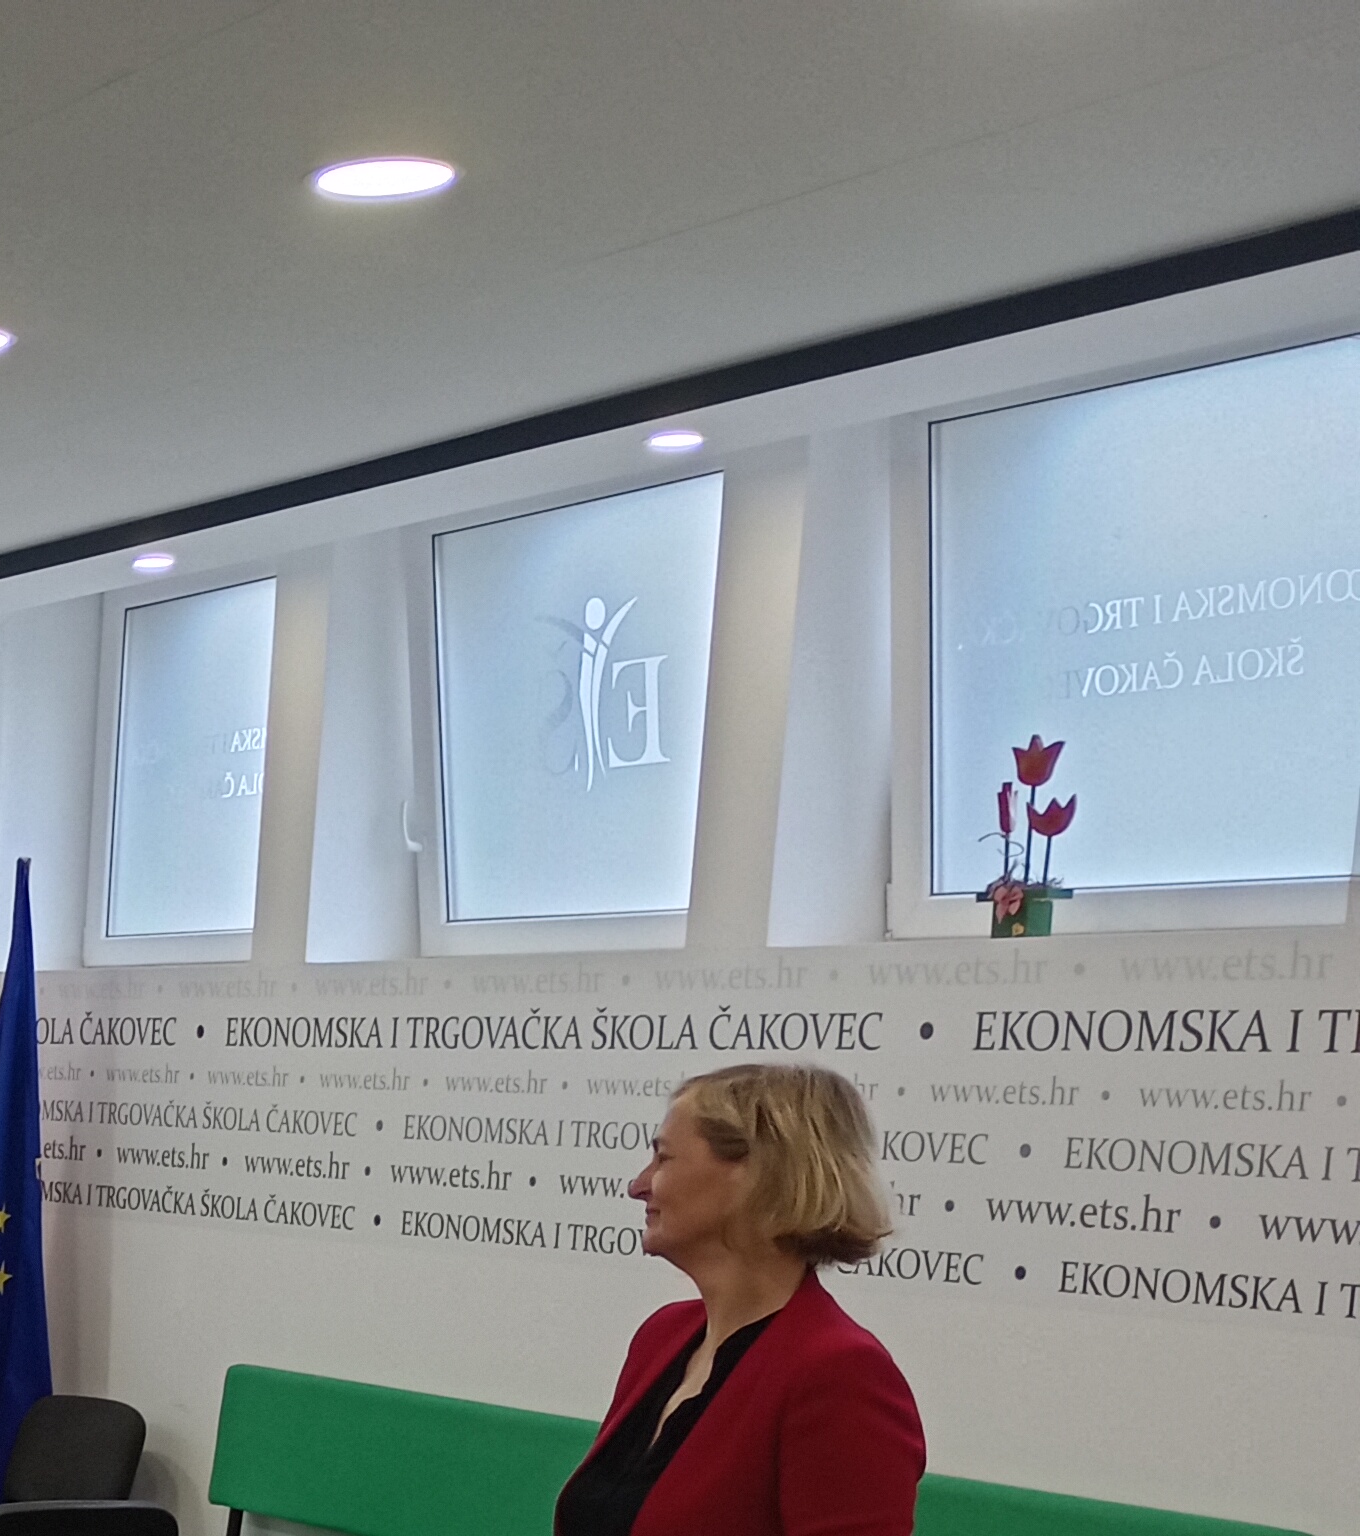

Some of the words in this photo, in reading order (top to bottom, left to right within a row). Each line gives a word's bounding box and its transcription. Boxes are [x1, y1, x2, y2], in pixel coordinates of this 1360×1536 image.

[314, 968, 428, 997] www.ets.hr
[471, 965, 604, 994] www.ets.hr
[654, 956, 808, 991] www.ets.hr
[868, 948, 1047, 986] www.ets.hr
[1121, 940, 1333, 982] www.ets.hr
[80, 1011, 177, 1047] ČAKOVEC
[225, 1016, 383, 1048] EKONOMSKA
[390, 1016, 400, 1048] I
[407, 1007, 582, 1050] TRGOVAČKA
[591, 1007, 699, 1050] ŠKOLA
[709, 1005, 883, 1051] ČAKOVEC
[973, 1009, 1272, 1053] EKONOMSKA
[1286, 1009, 1304, 1053] I
[106, 1063, 180, 1084] www.ets.hr
[207, 1065, 289, 1088] www.ets.hr
[319, 1068, 410, 1092] www.ets.hr
[445, 1069, 547, 1095] www.ets.hr
[930, 1076, 1079, 1106] www.ets.hr
[1140, 1079, 1312, 1112] www.ets.hr
[88, 1101, 95, 1123] I
[97, 1100, 198, 1129] TRGOVAČKA
[202, 1102, 260, 1132] ŠKOLA
[266, 1104, 357, 1137] ČAKOVEC
[404, 1114, 549, 1147] EKONOMSKA
[556, 1120, 565, 1147] I
[1064, 1136, 1309, 1181] EKONOMSKA
[1321, 1146, 1335, 1182] I
[117, 1143, 209, 1170] www.ets.hr
[245, 1151, 349, 1180] www.ets.hr
[391, 1160, 512, 1191] www.ets.hr
[986, 1194, 1182, 1234] www.ets.hr
[87, 1183, 94, 1206] I
[96, 1185, 196, 1217] TRGOVAČKA
[200, 1188, 258, 1222] ŠKOLA
[264, 1194, 356, 1231] ČAKOVEC
[401, 1210, 547, 1249] EKONOMSKA
[552, 1222, 561, 1250] I
[1058, 1261, 1303, 1315] EKONOMSKA
[1315, 1281, 1329, 1316] I
